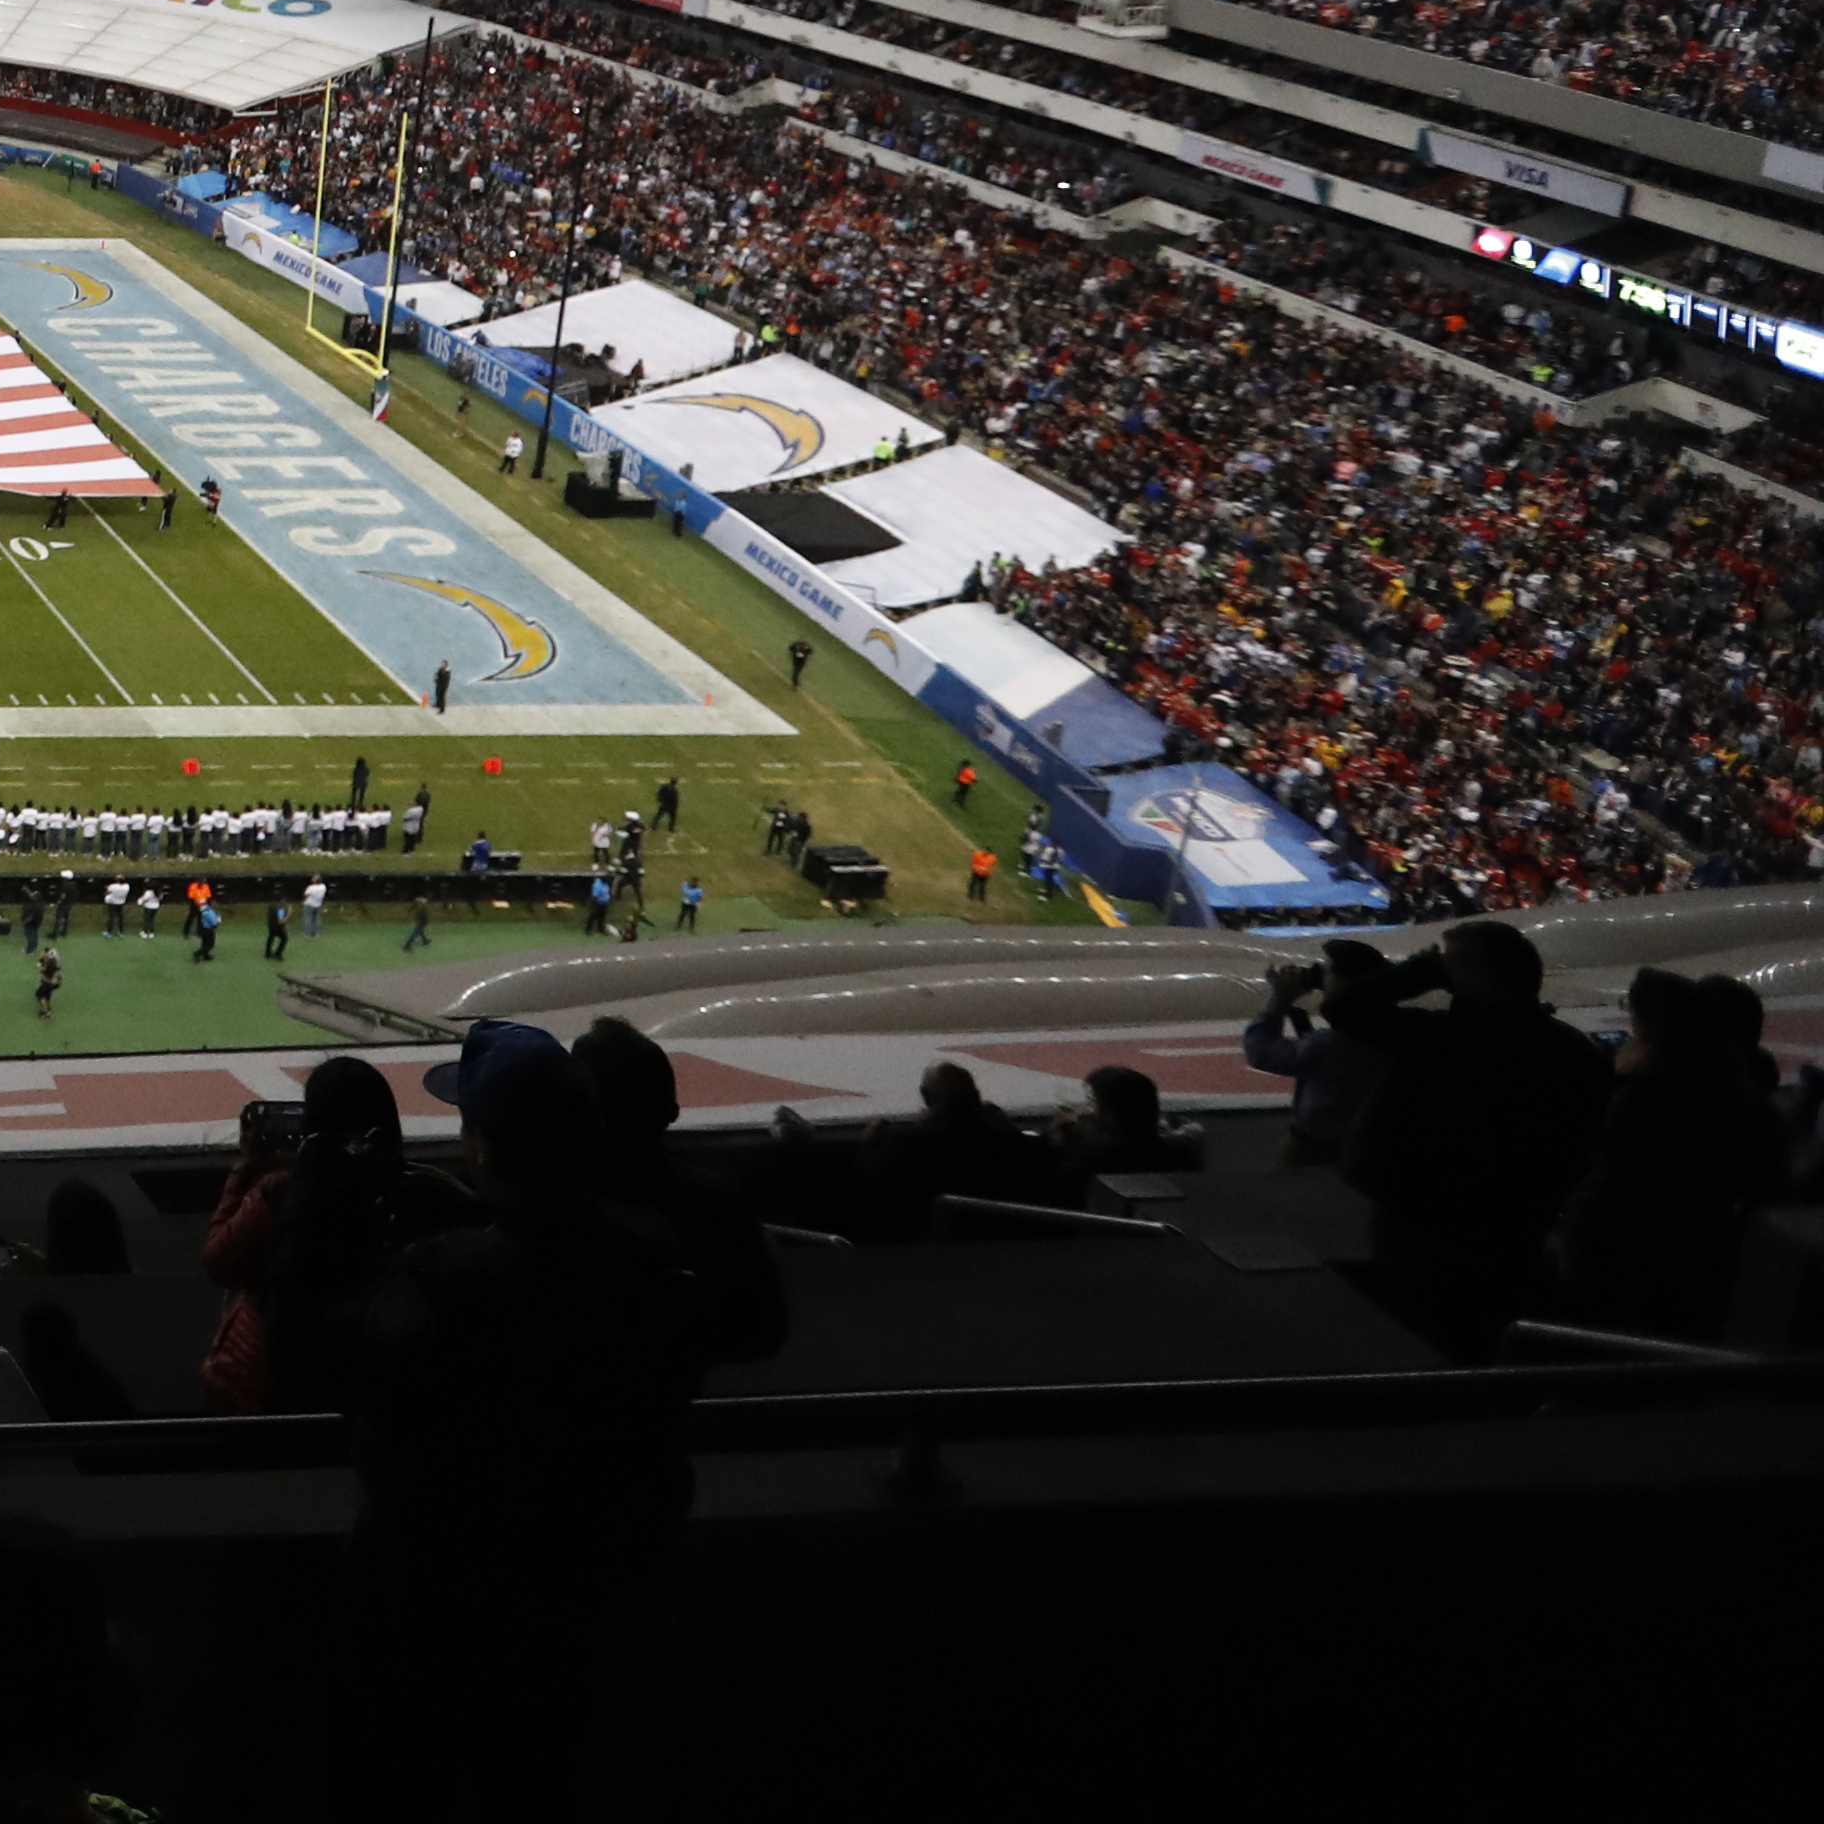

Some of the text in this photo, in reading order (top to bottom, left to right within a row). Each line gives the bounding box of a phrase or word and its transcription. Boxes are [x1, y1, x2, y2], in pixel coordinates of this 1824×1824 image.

[1504, 160, 1549, 187] VISA
[272, 249, 312, 278] MEXICO
[426, 326, 453, 362] LOS
[46, 316, 458, 558] CHARGERS
[745, 540, 845, 622] MEXICO GAME
